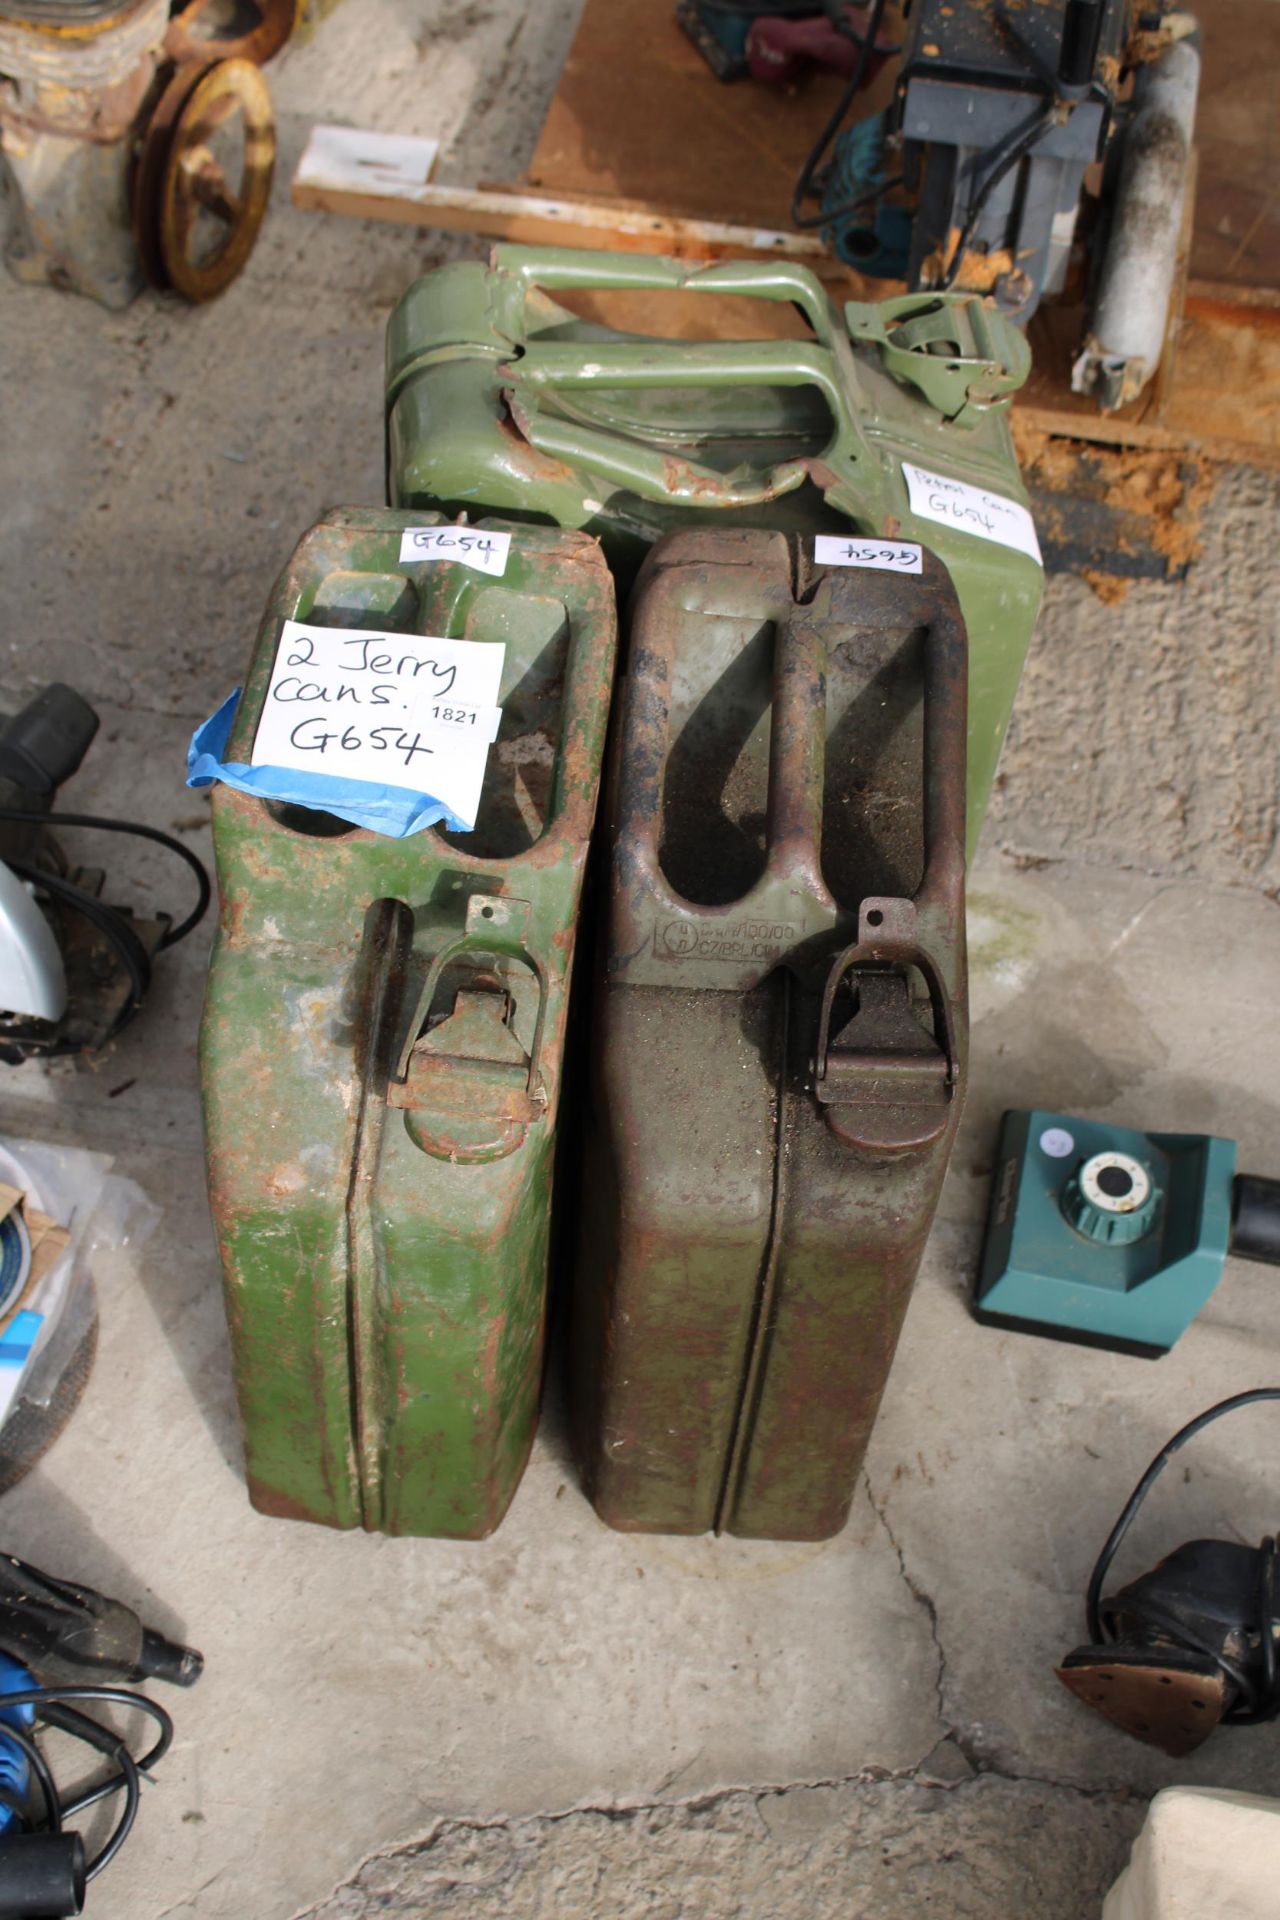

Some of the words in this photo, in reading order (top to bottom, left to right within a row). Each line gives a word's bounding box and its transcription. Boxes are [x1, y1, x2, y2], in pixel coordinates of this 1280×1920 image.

[928, 493, 995, 533] G654
[413, 532, 499, 565] G654
[840, 544, 918, 565] G654
[287, 637, 320, 667] 2
[338, 638, 457, 697] Jerry
[432, 706, 476, 725] 1821
[290, 717, 434, 766] G654
